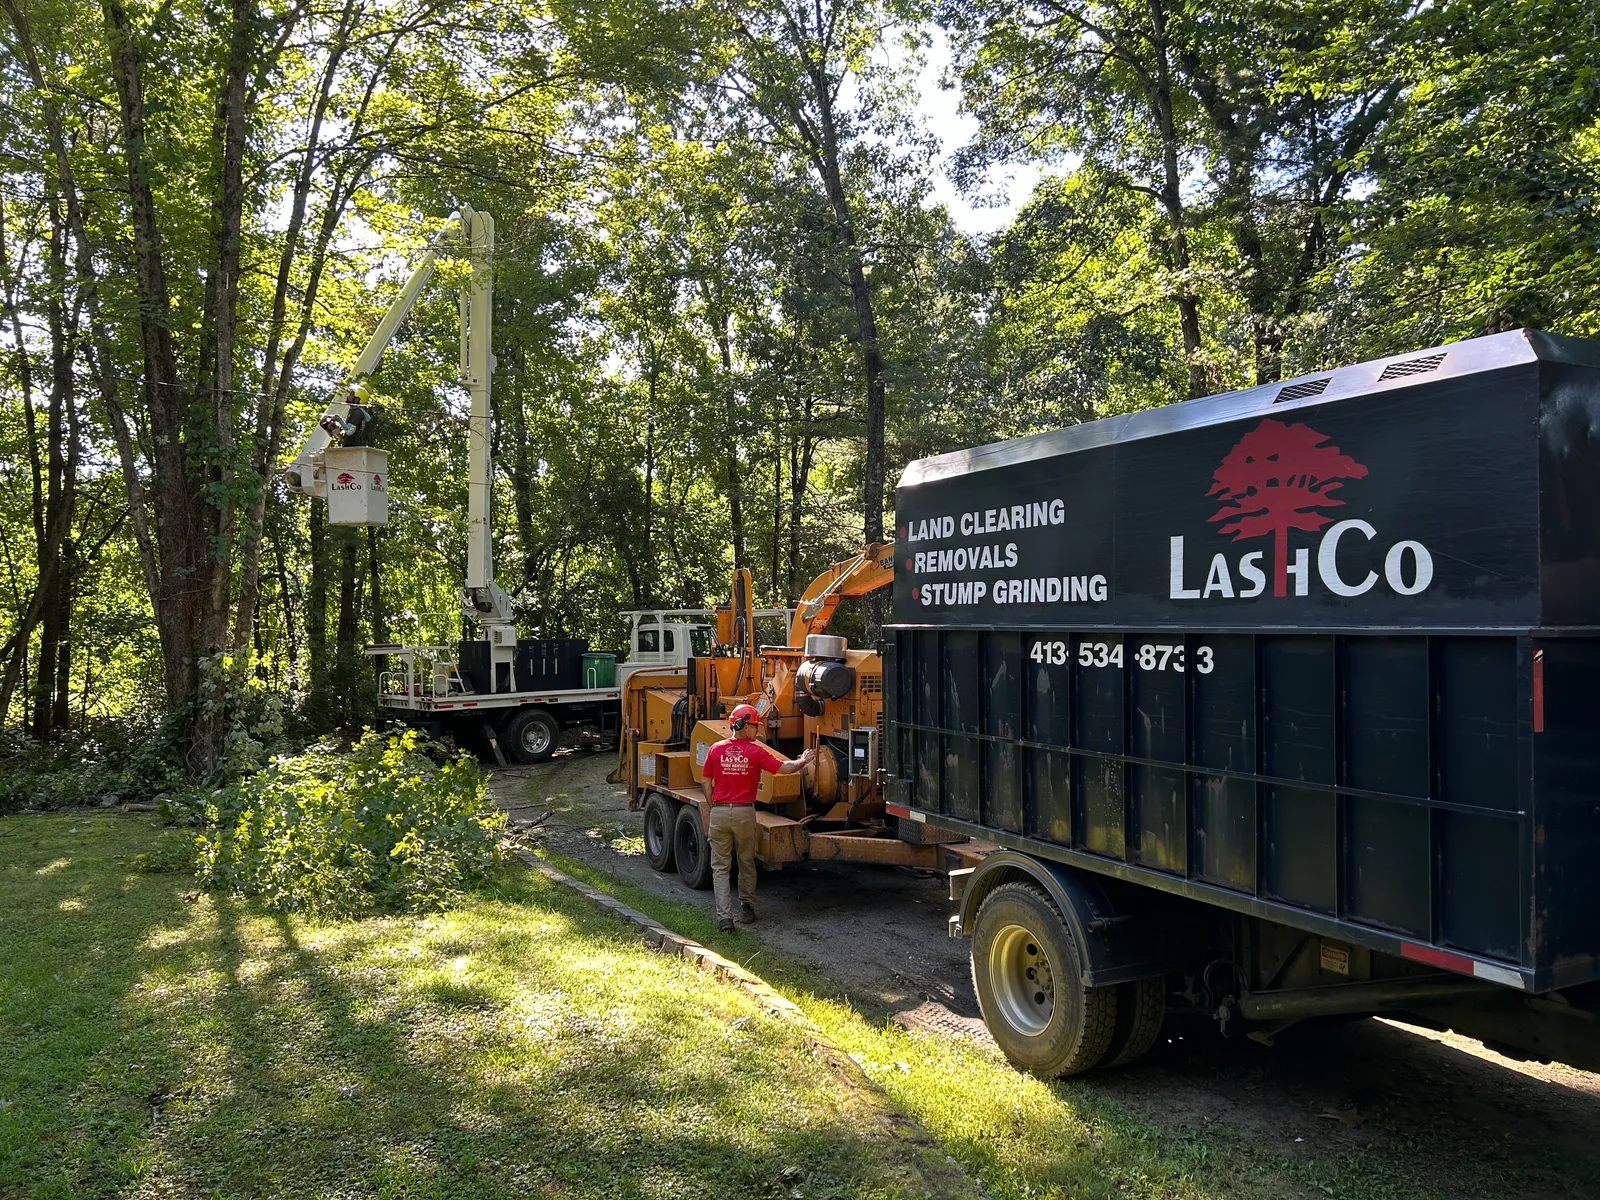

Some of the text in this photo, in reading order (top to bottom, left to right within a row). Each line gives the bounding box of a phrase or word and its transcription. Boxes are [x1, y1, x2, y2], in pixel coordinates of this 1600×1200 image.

[908, 498, 1065, 542] LAND CLEARING
[914, 542, 1018, 574] REMOVALS
[920, 574, 1108, 606] STUMP GRINDING
[1078, 642, 1123, 669] 534
